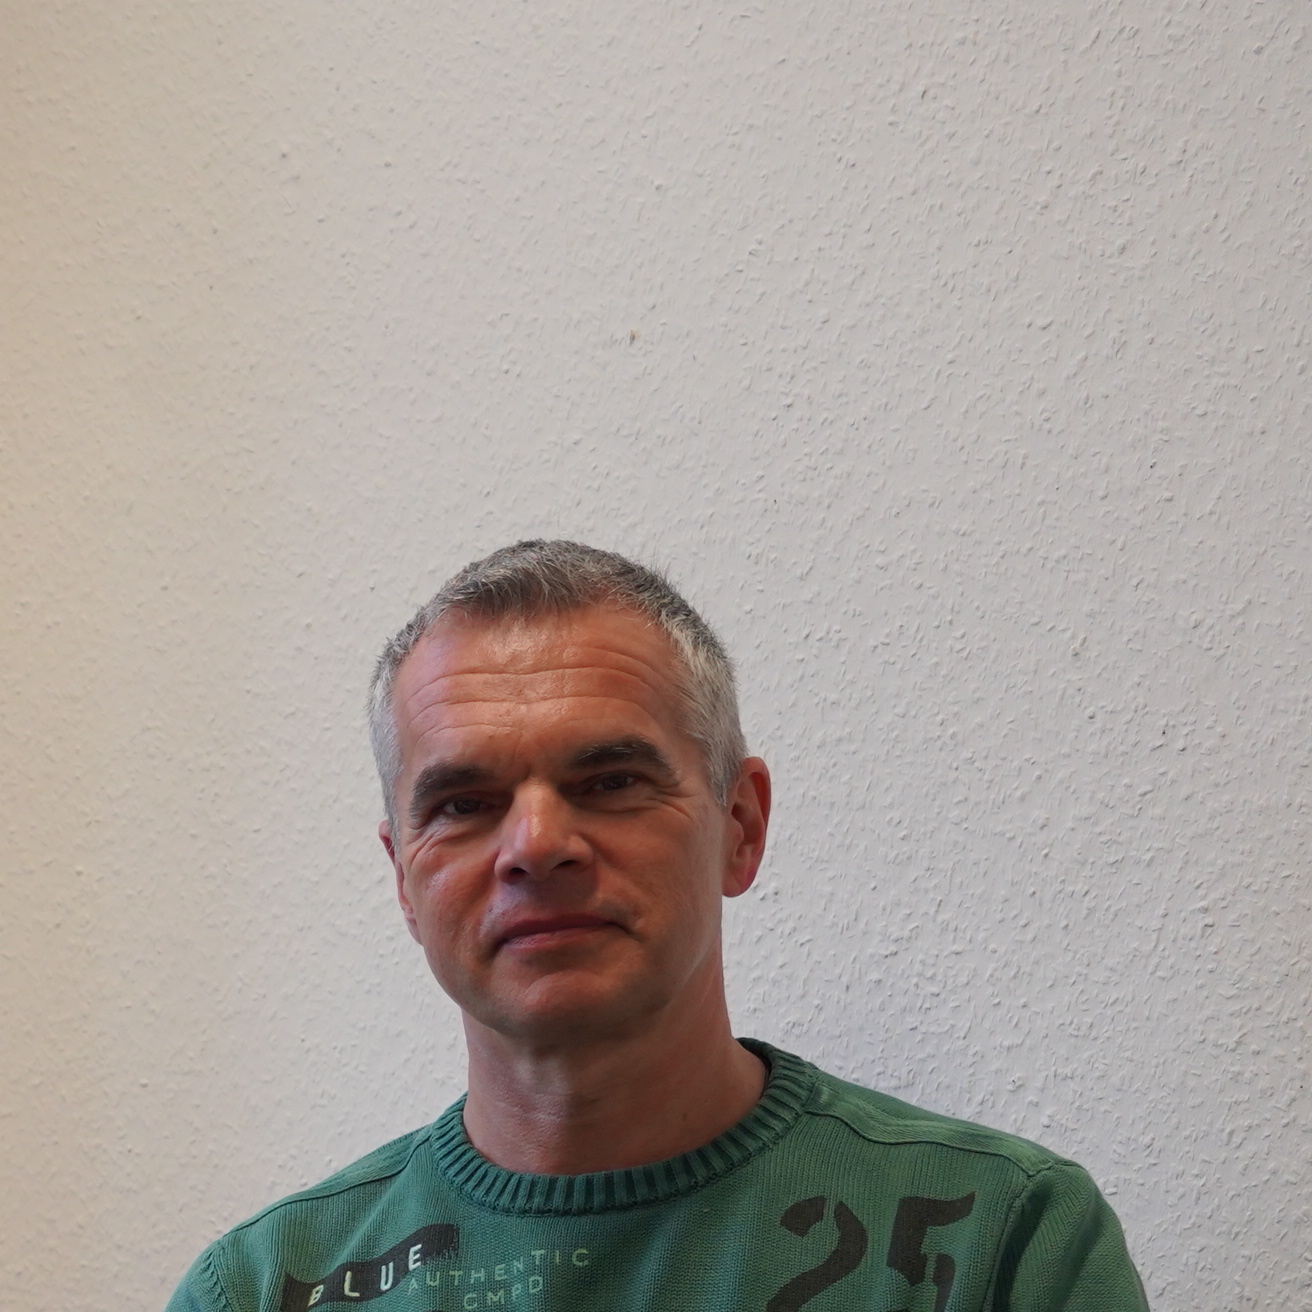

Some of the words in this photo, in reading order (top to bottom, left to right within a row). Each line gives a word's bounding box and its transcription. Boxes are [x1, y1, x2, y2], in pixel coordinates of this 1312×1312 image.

[307, 1243, 422, 1307] BLUE
[407, 1248, 590, 1295] AUTHENTIC
[463, 1275, 544, 1310] CMPD
